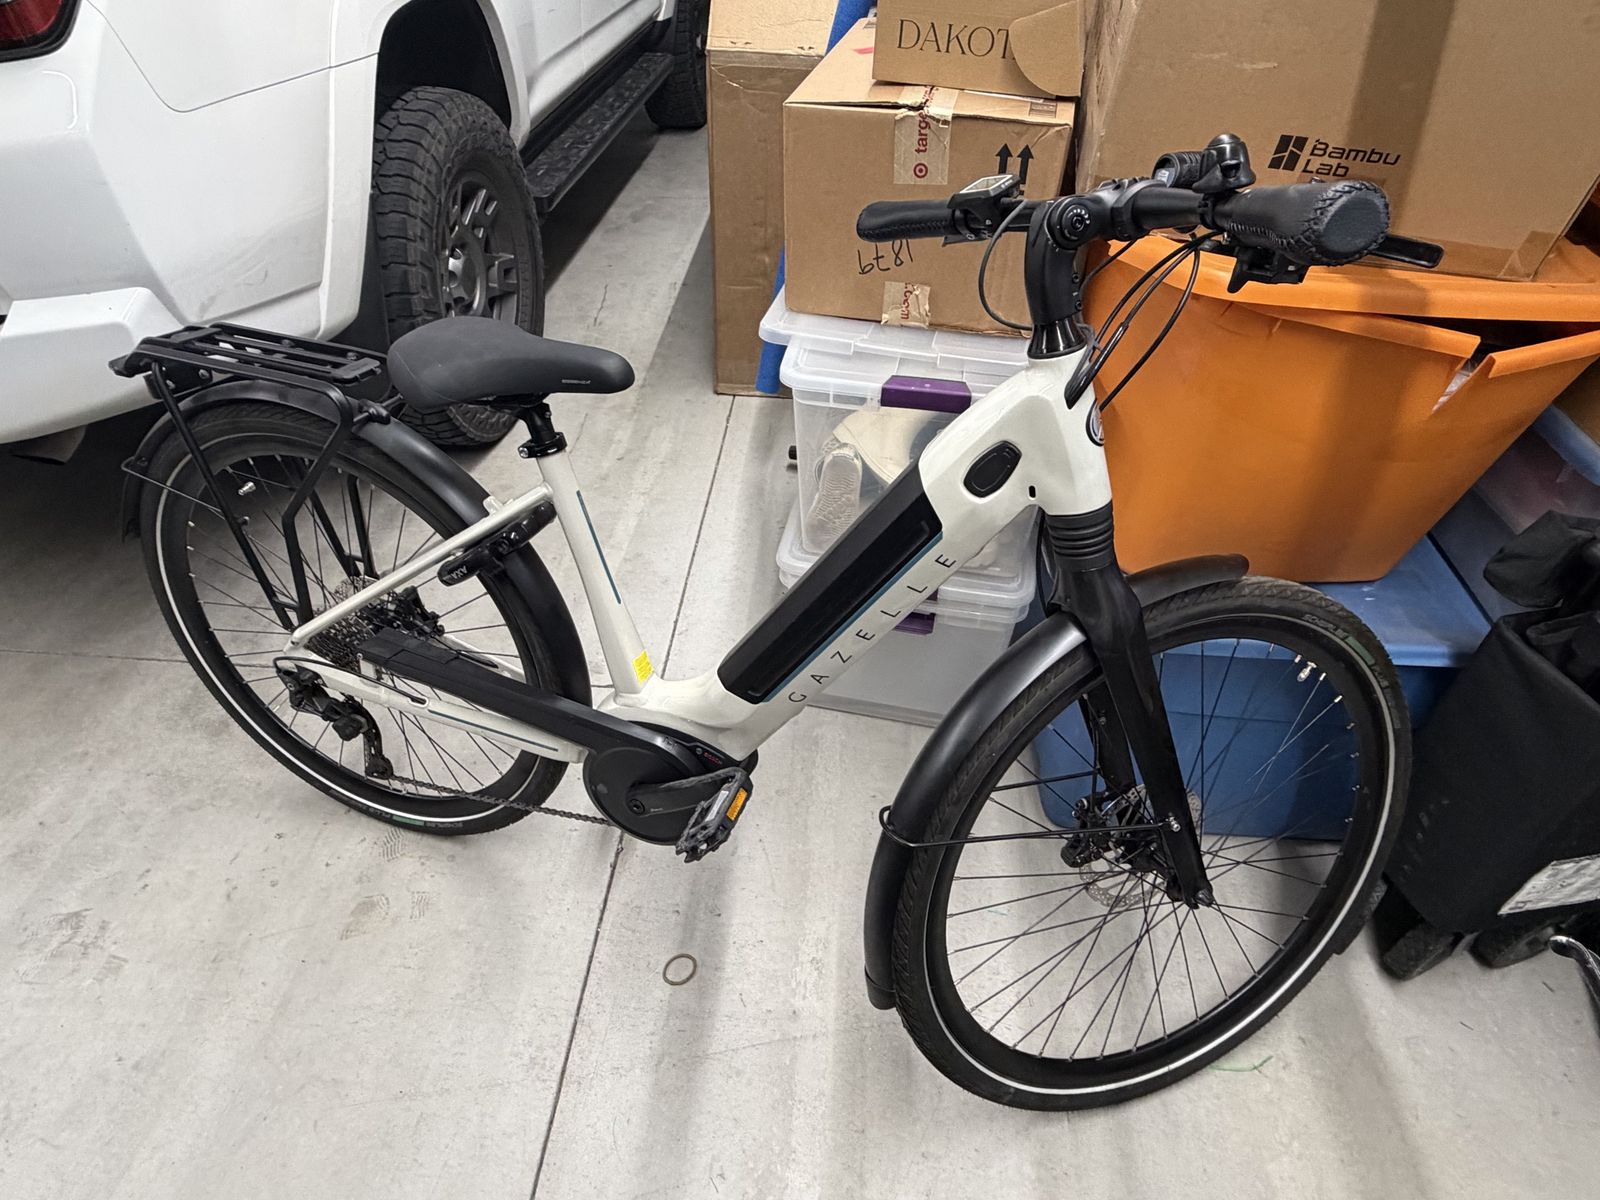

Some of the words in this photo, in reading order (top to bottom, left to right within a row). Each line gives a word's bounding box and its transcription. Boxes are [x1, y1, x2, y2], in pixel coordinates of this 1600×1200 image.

[897, 19, 1015, 60] DAKOT
[1302, 158, 1350, 177] Lab
[1309, 140, 1401, 165] Bambu
[788, 554, 956, 703] GAZELLE
